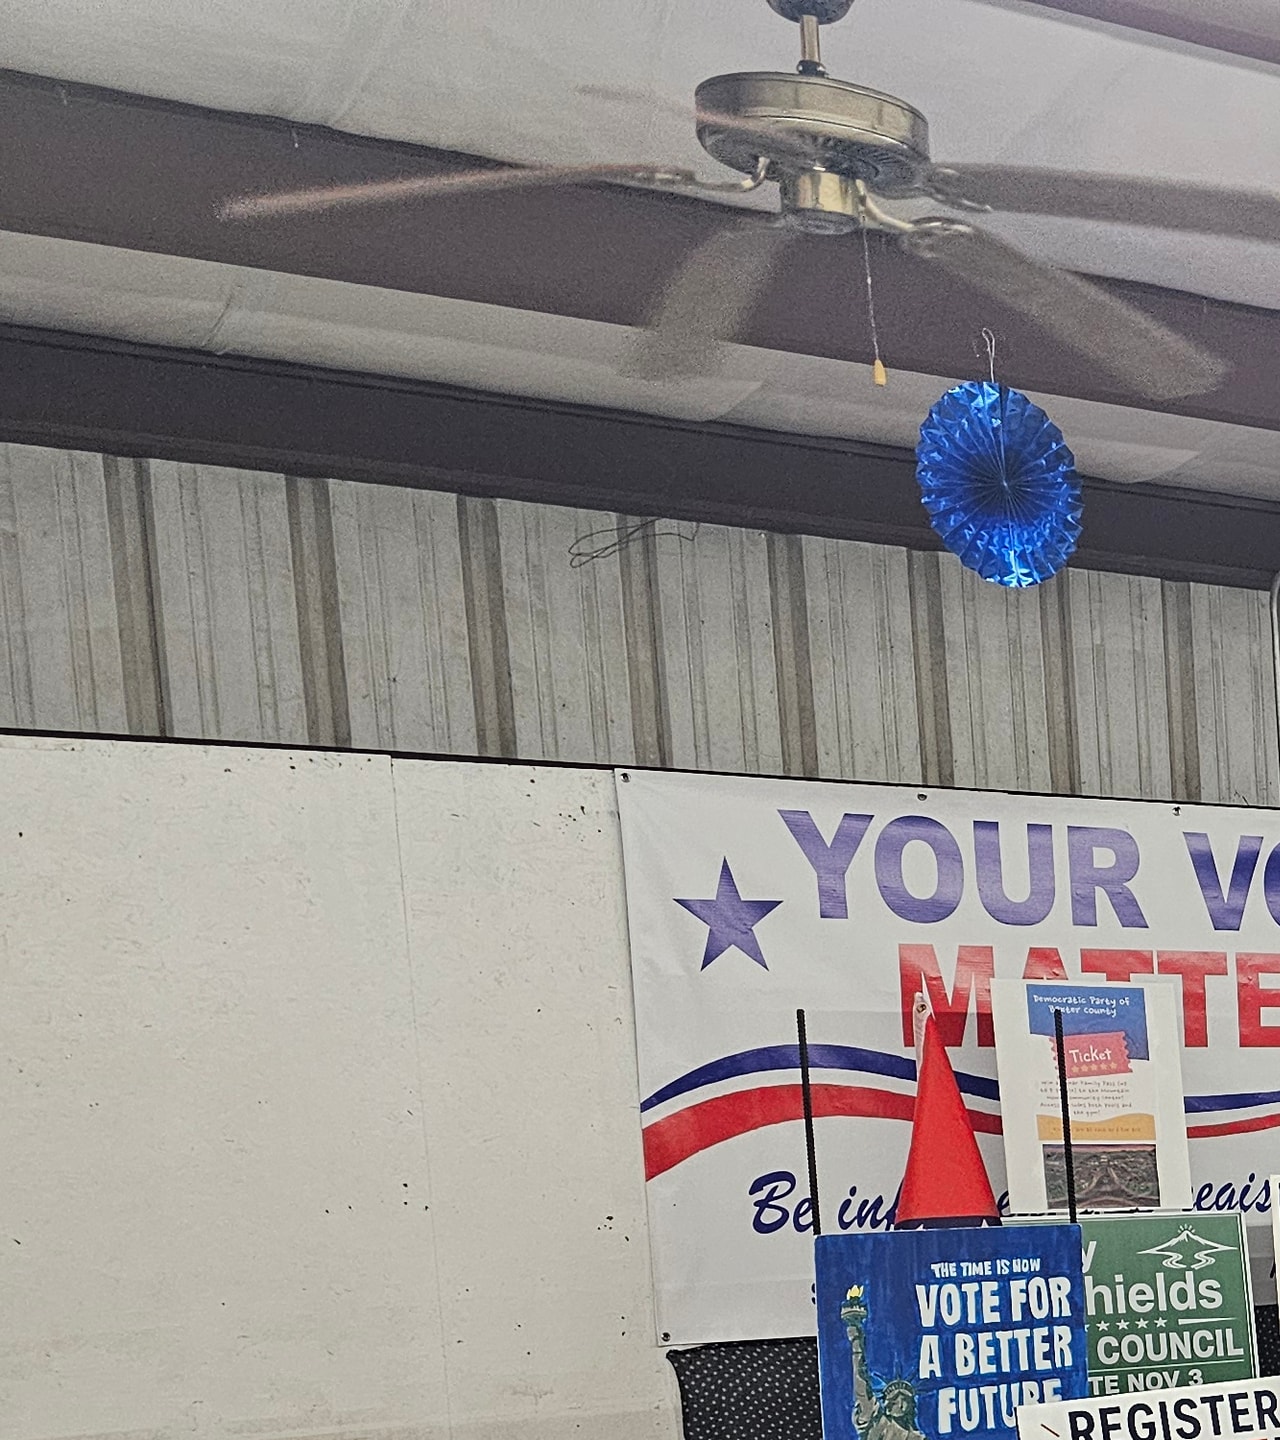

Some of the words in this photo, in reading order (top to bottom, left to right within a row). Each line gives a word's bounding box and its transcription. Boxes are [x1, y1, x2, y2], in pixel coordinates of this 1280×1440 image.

[777, 809, 1149, 929] YOUR
[1033, 995, 1086, 1004] Democratic
[1089, 995, 1116, 1006] Party
[1119, 997, 1130, 1005] of
[1069, 1045, 1112, 1063] Ticket
[749, 1171, 814, 1234] Be
[930, 1262, 958, 1278] THE
[960, 1261, 992, 1277] TIME
[997, 1259, 1010, 1275] IS
[1012, 1257, 1040, 1274] NOW
[915, 1282, 1001, 1328] VOTE
[1009, 1276, 1072, 1322] FOR
[1086, 1271, 1223, 1316] hields
[918, 1335, 942, 1379] A
[955, 1326, 1073, 1377] BETTER
[1096, 1329, 1244, 1364] COUNCIL
[1133, 1372, 1180, 1392] NOV
[1189, 1369, 1203, 1386] 3
